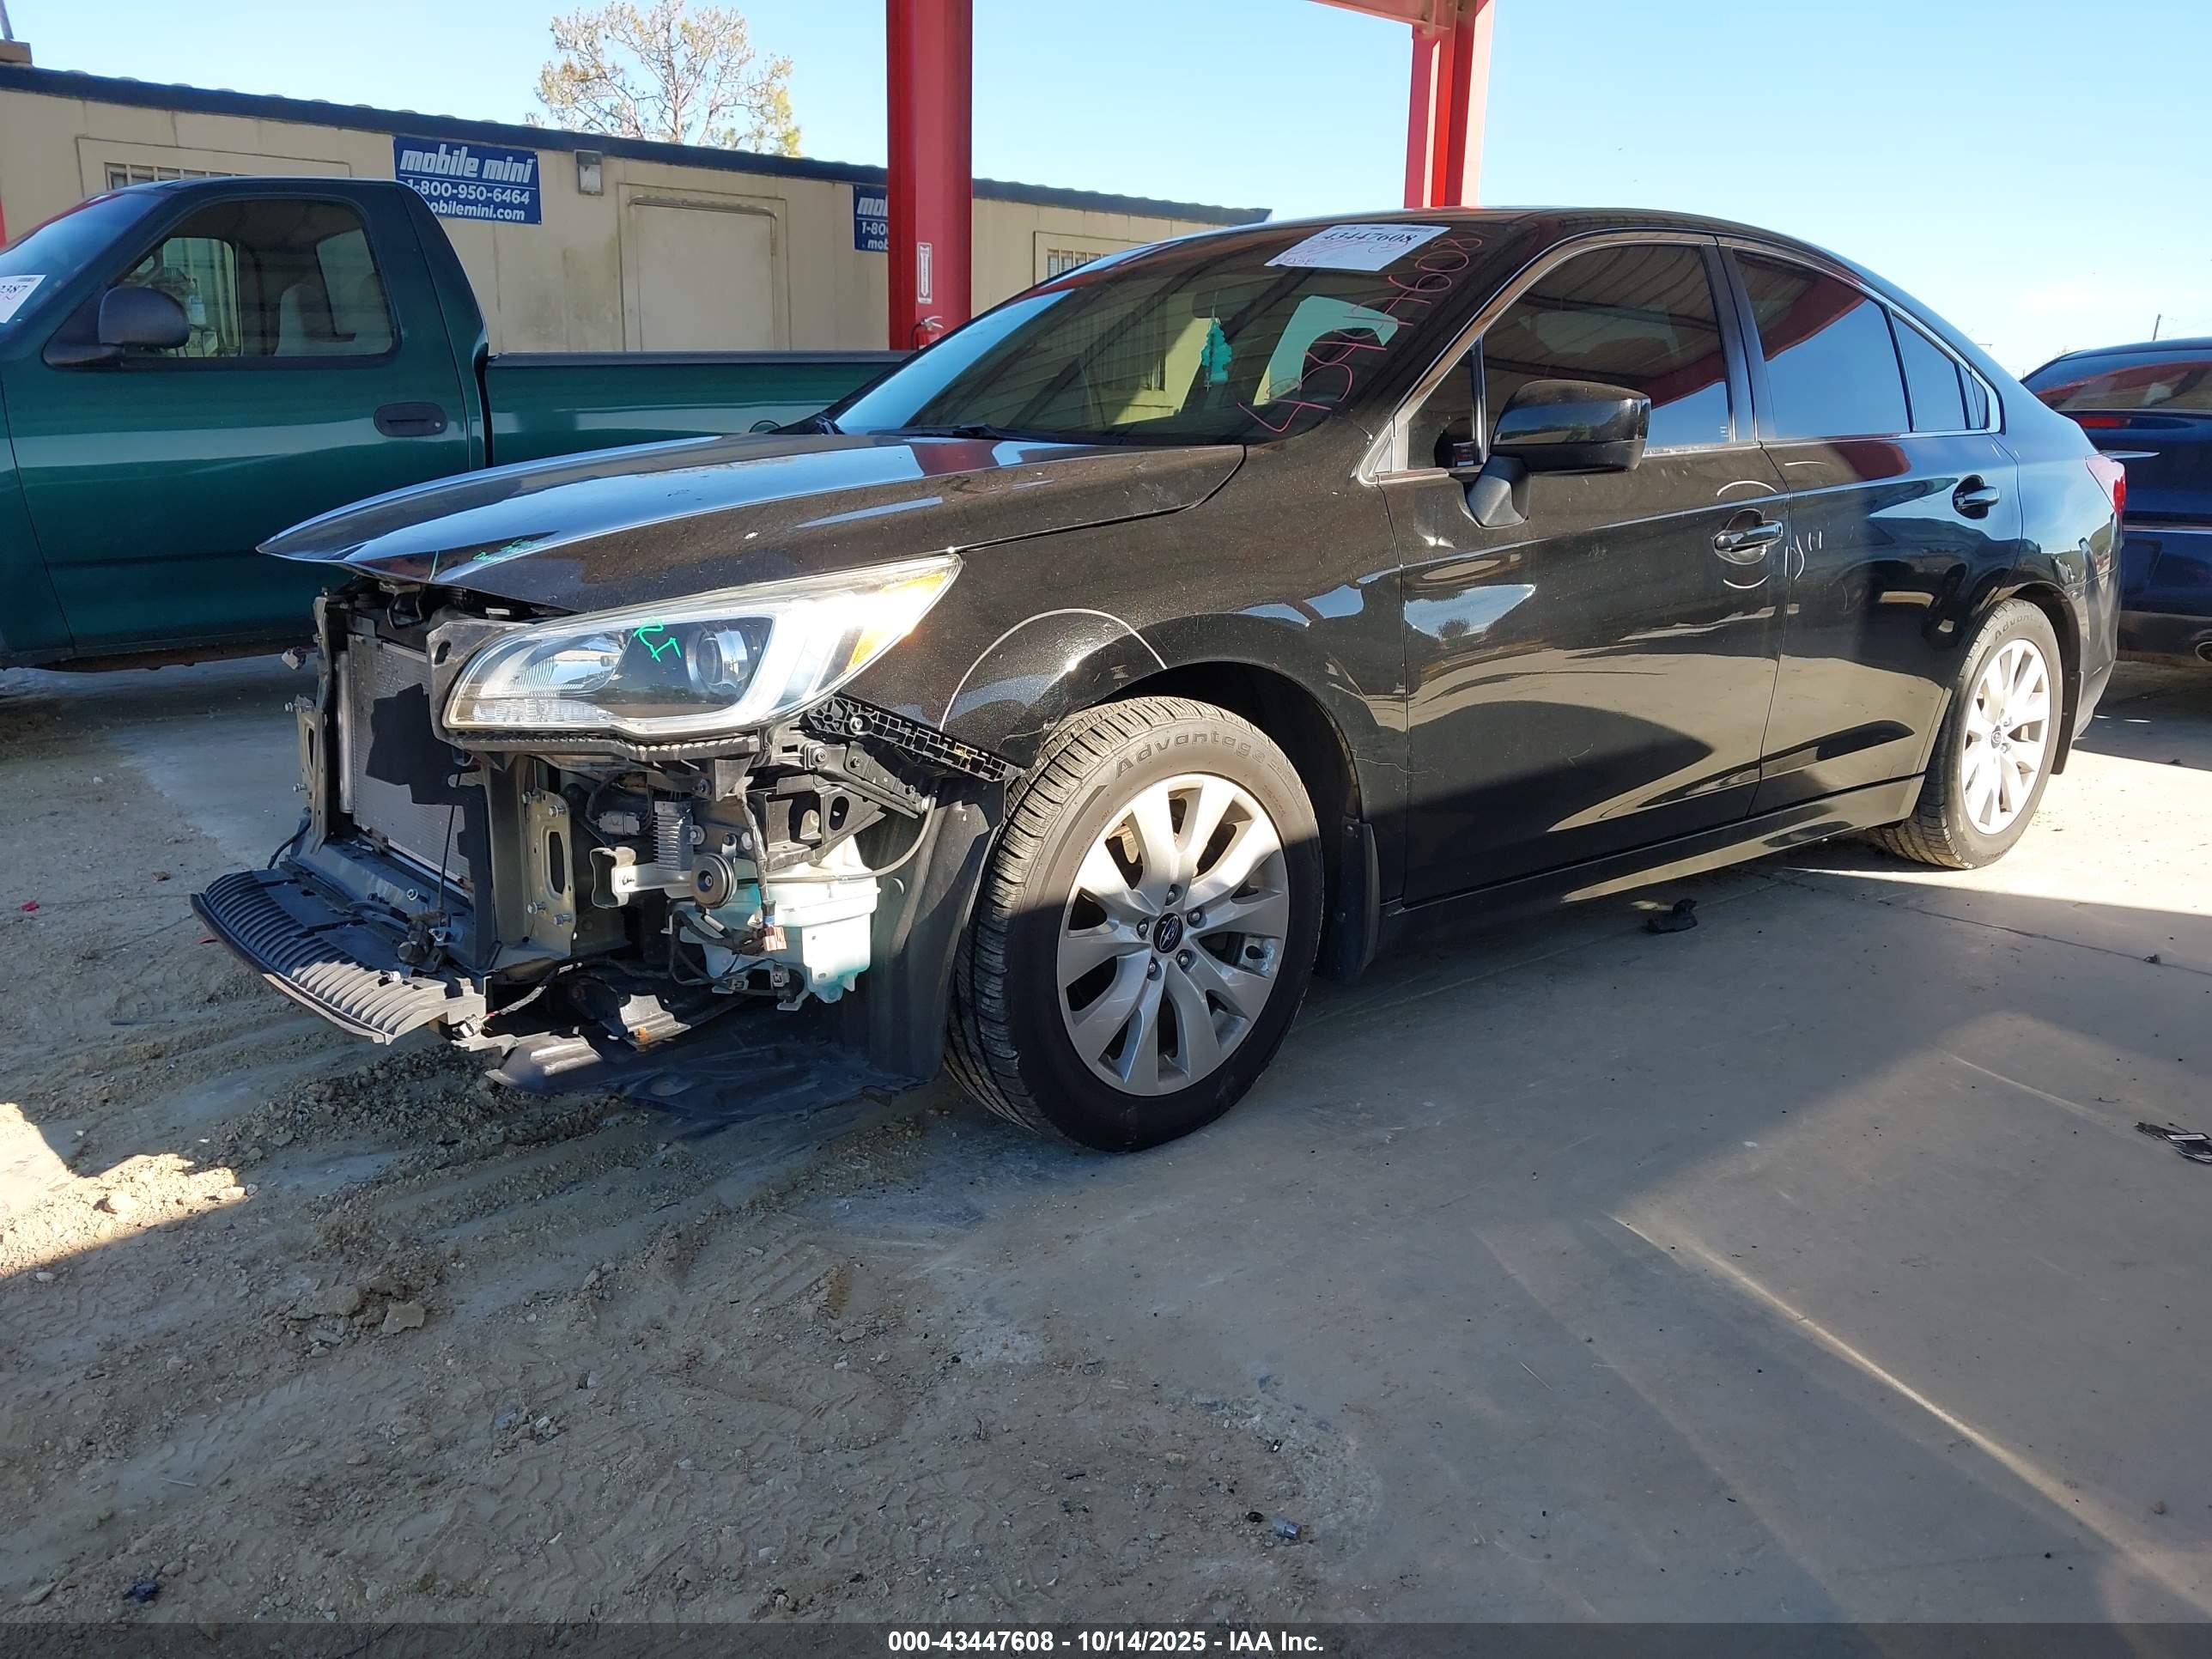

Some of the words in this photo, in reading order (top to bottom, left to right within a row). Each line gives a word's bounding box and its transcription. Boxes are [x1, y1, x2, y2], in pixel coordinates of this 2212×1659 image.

[399, 143, 480, 179] mobile
[482, 155, 535, 184] mini
[407, 179, 531, 205] 1-800-950-6464
[427, 199, 526, 222] obilemini.com
[861, 222, 888, 235] 1-80
